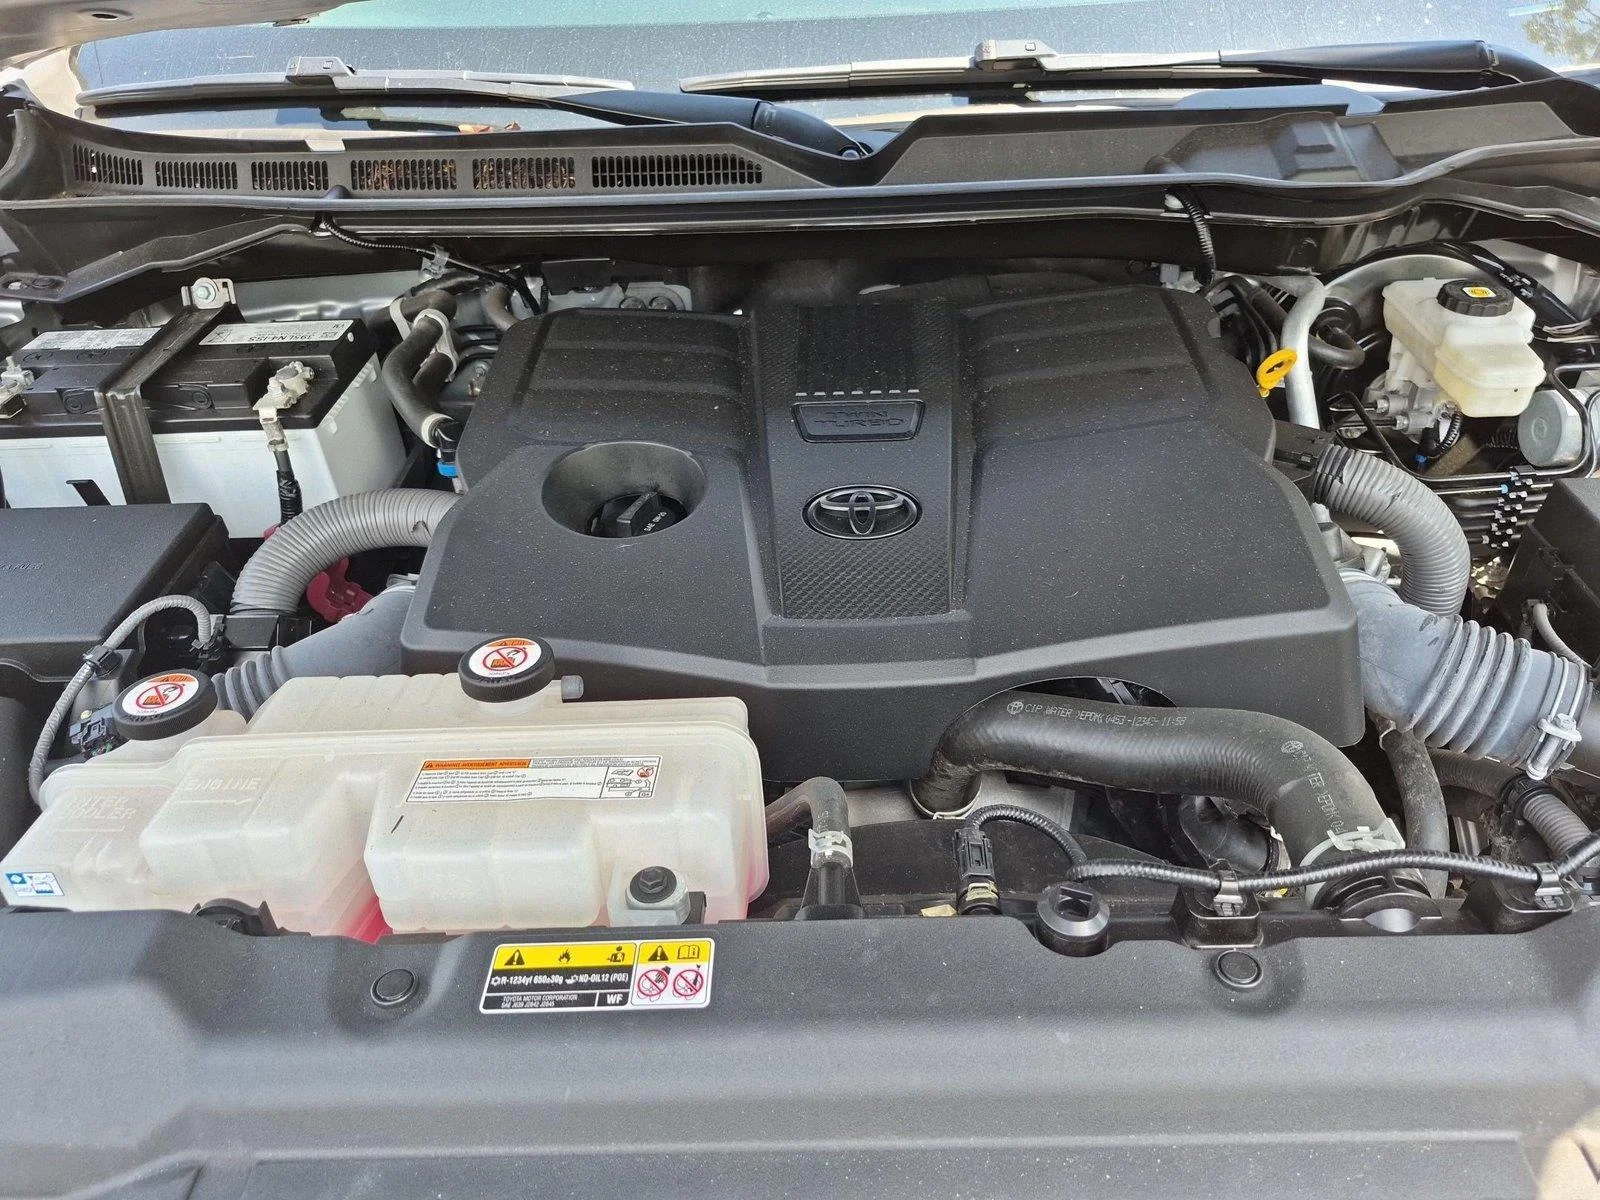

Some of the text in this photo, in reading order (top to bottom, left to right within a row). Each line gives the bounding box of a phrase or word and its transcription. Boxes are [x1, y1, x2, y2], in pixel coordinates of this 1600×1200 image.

[814, 417, 904, 427] TURBO
[1025, 703, 1043, 713] CIP
[1045, 705, 1073, 718] WATER
[184, 776, 262, 791] ENGINE
[501, 975, 532, 986] R-1234yf
[610, 973, 629, 983] (POE)
[606, 994, 624, 1005] WF
